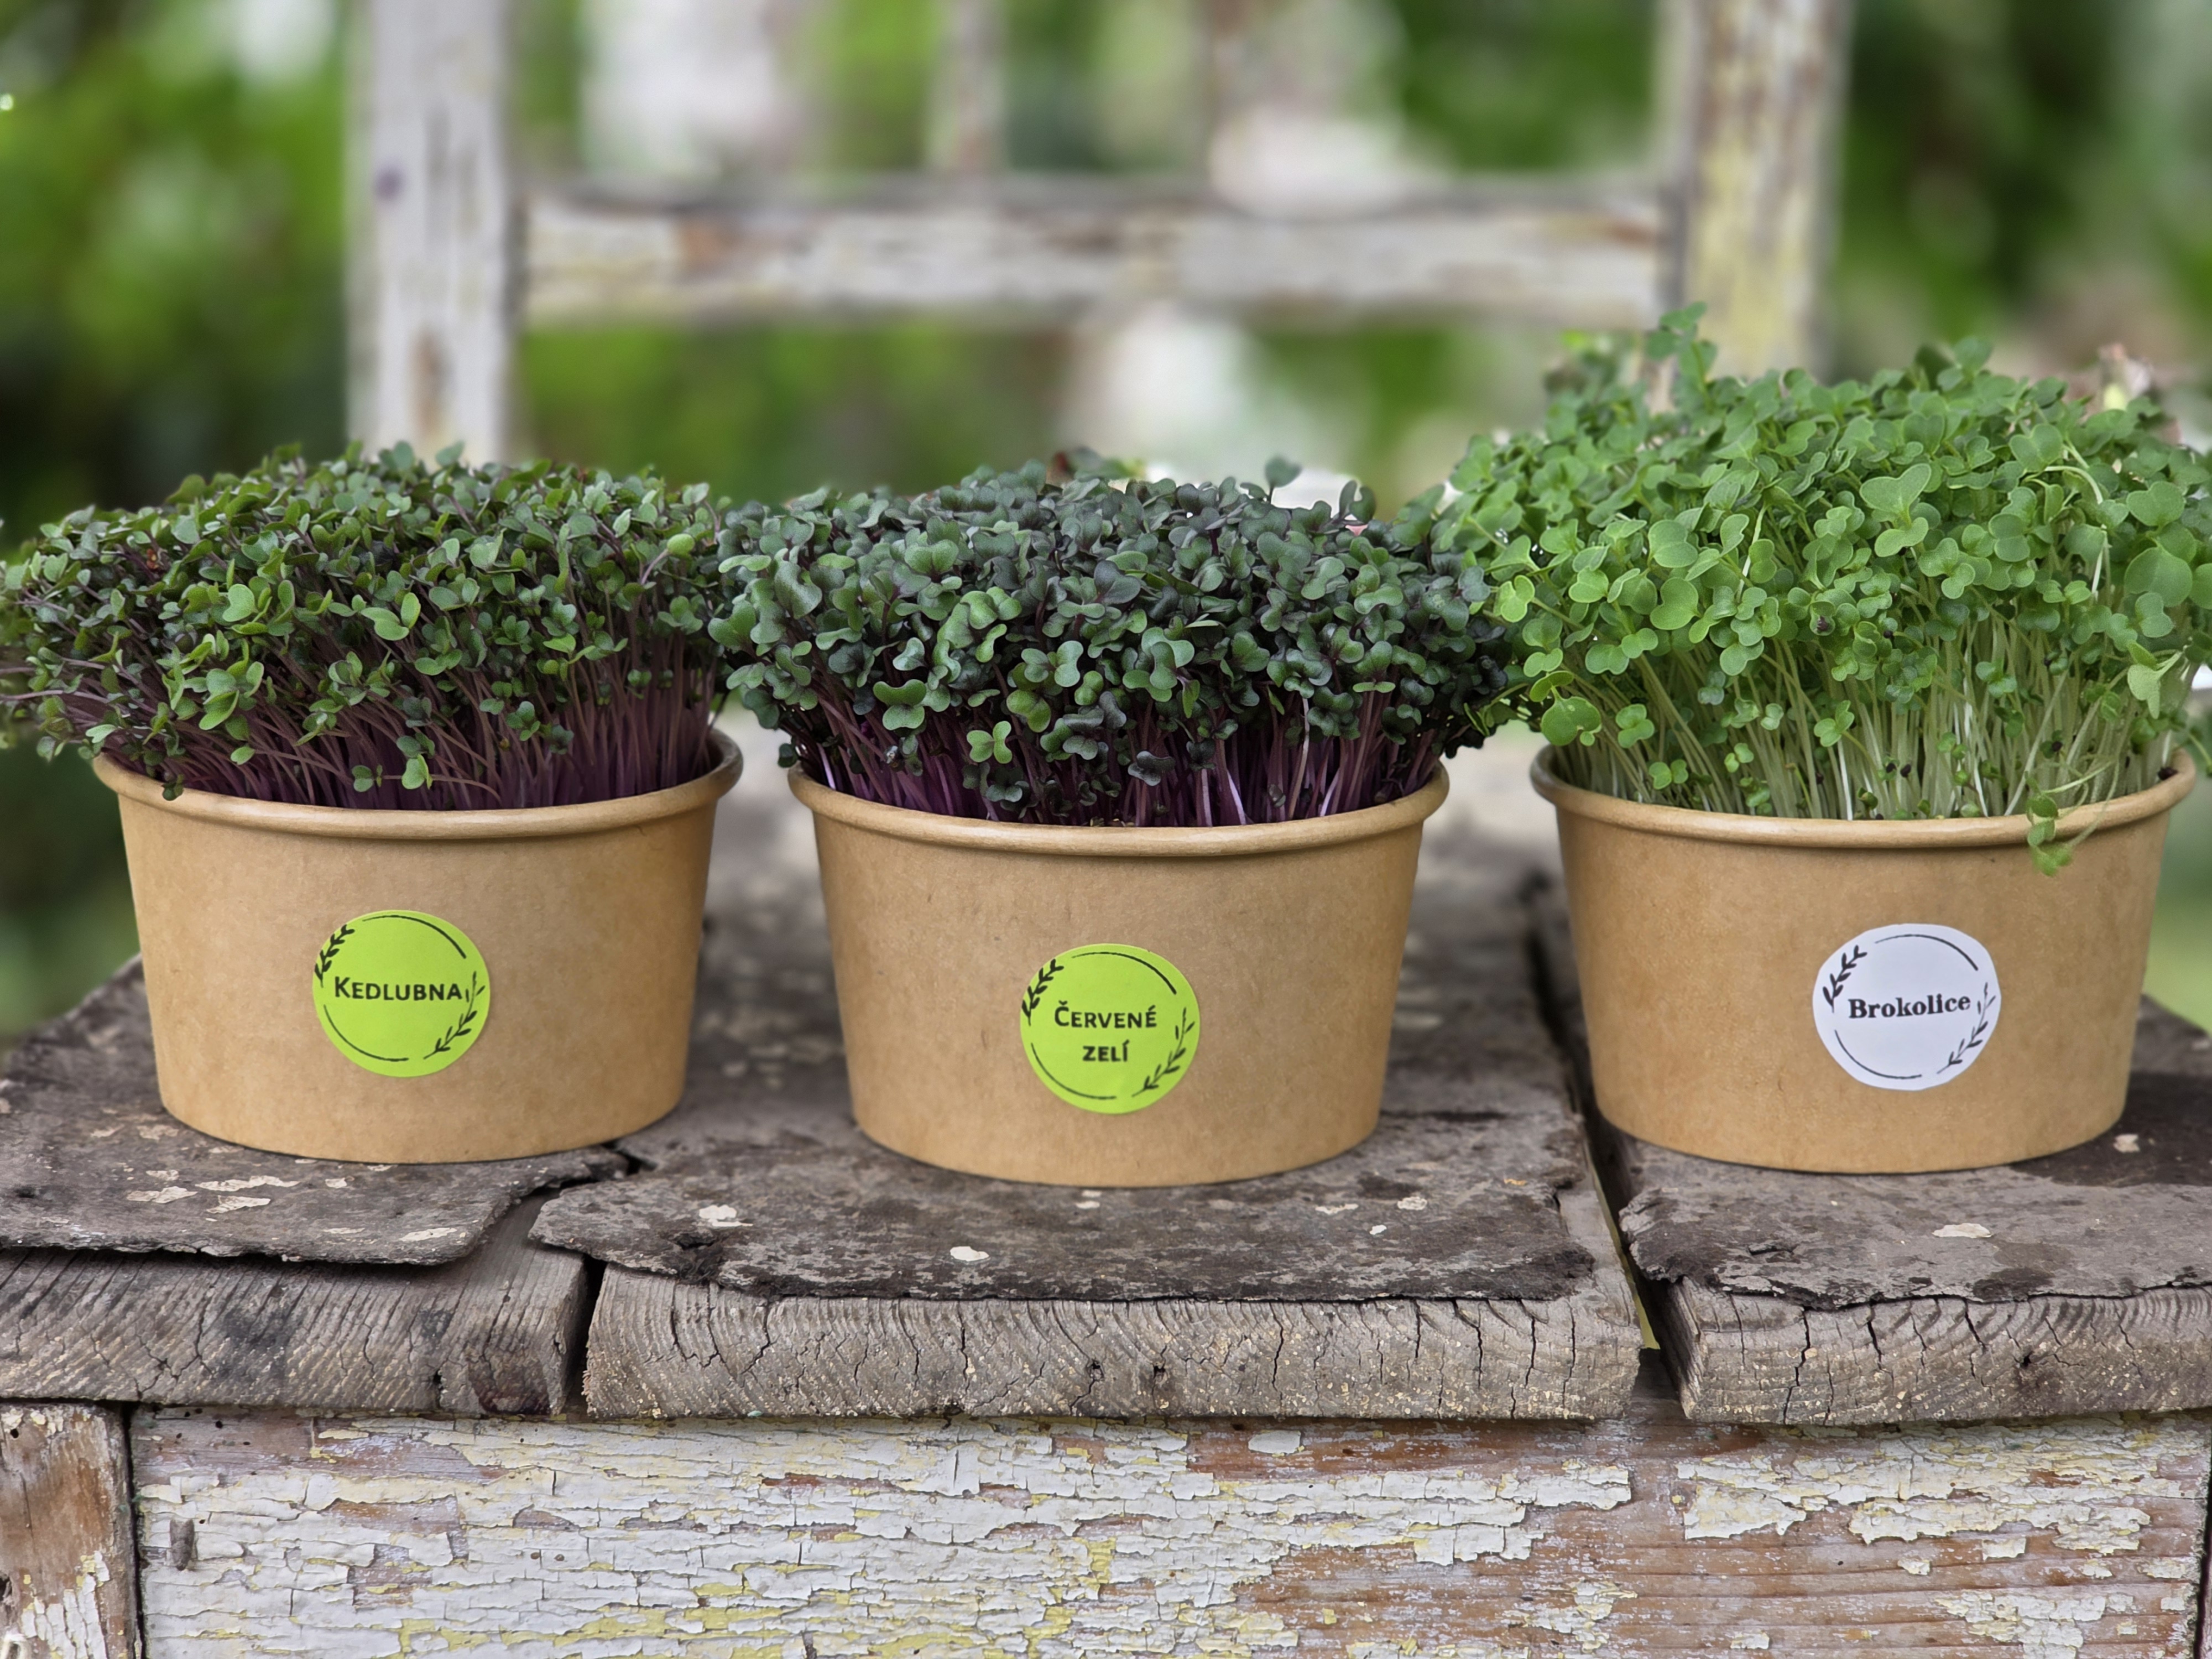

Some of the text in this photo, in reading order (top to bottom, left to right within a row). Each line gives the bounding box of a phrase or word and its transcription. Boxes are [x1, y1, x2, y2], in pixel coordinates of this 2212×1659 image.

[334, 975, 463, 1001] KEDLUBNA
[1054, 1000, 1157, 1029] ČERVENÉ
[1848, 993, 1971, 1019] Brokolice
[1082, 1039, 1130, 1062] ZELÍ
